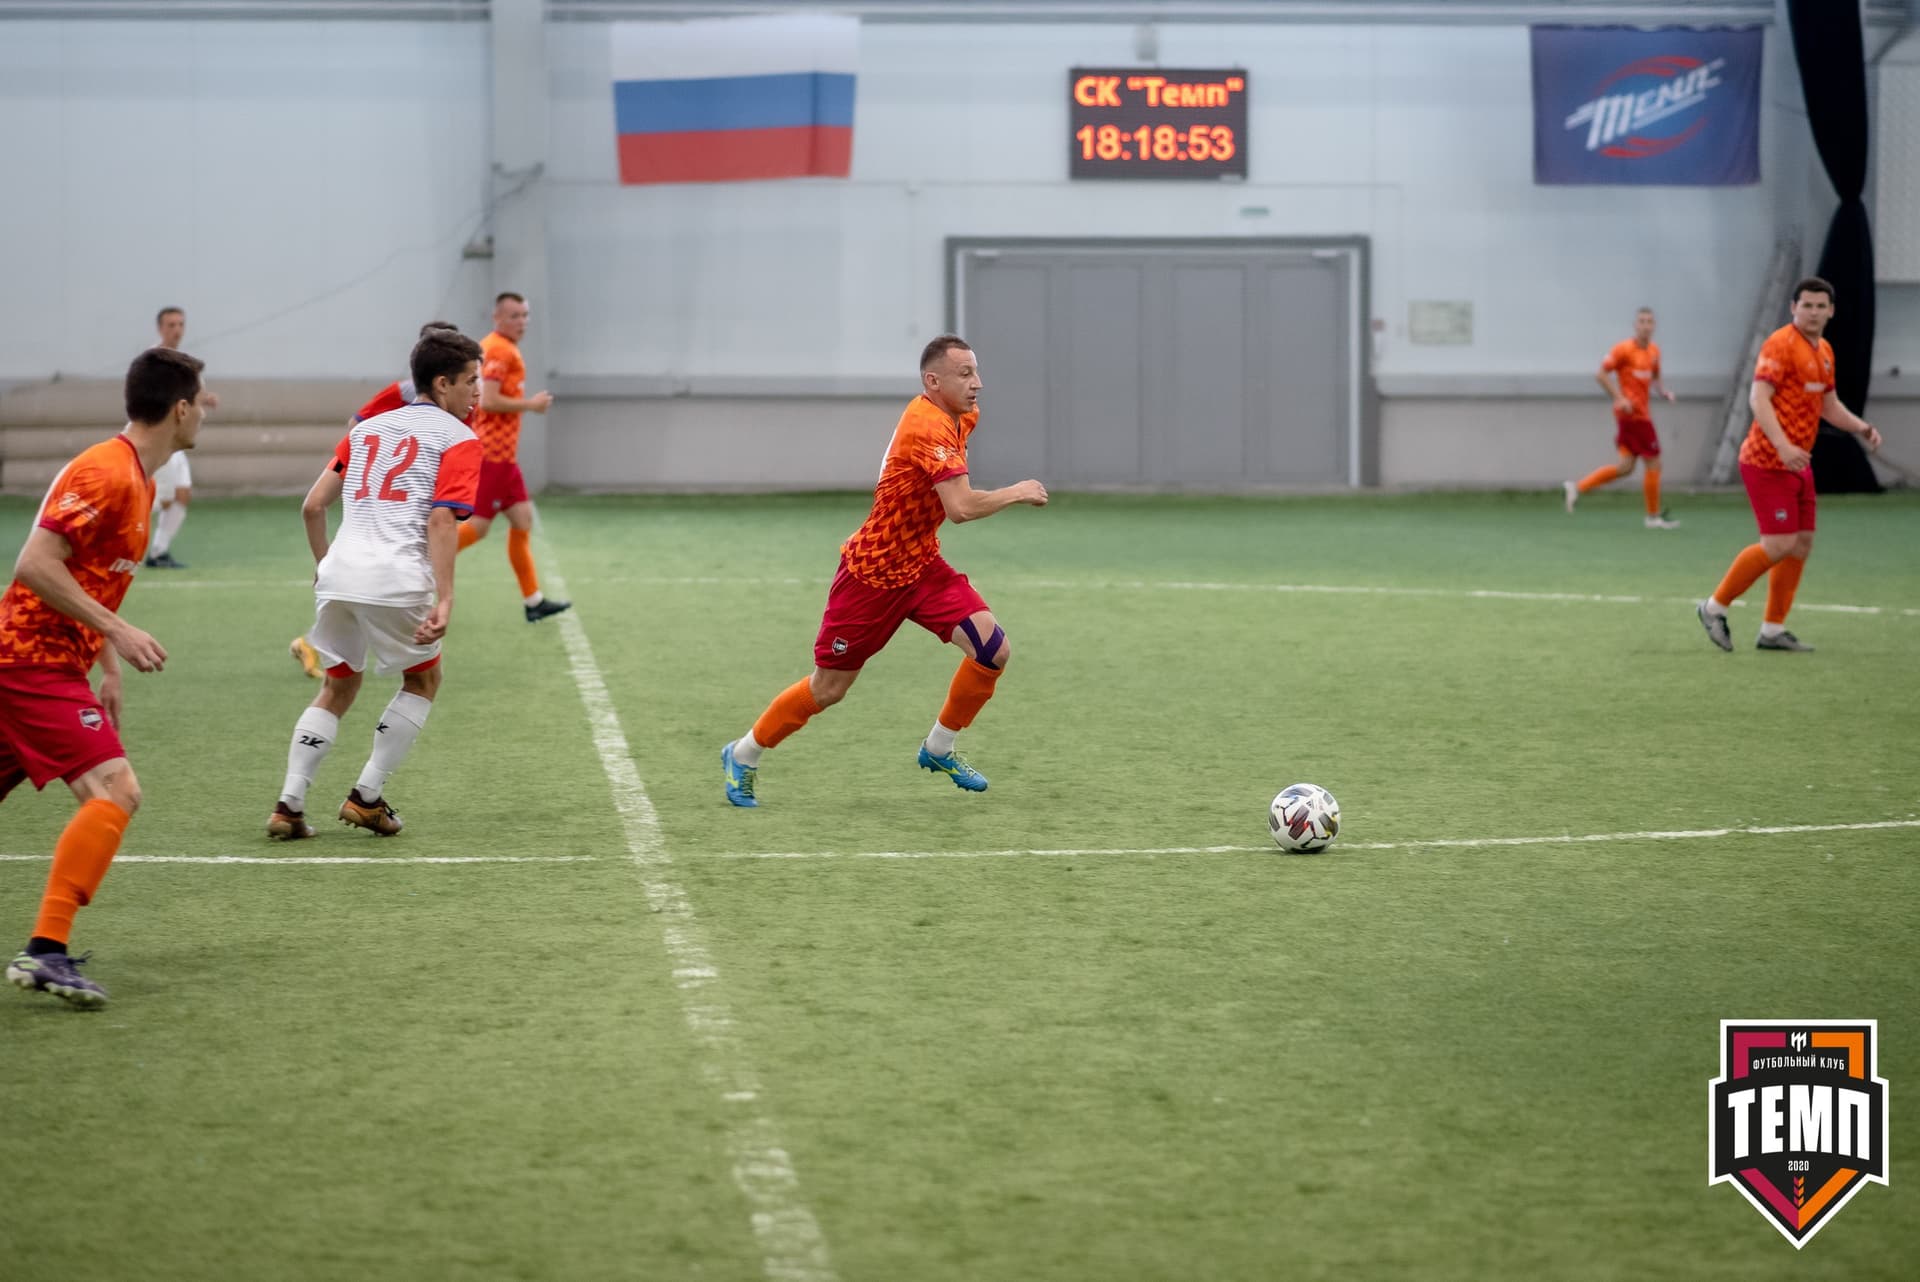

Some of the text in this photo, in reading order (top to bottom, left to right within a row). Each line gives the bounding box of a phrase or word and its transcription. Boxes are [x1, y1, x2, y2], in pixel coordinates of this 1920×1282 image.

[1074, 76, 1244, 107] СК "Темп"
[1076, 124, 1235, 161] 18:18:53
[354, 434, 419, 502] 12
